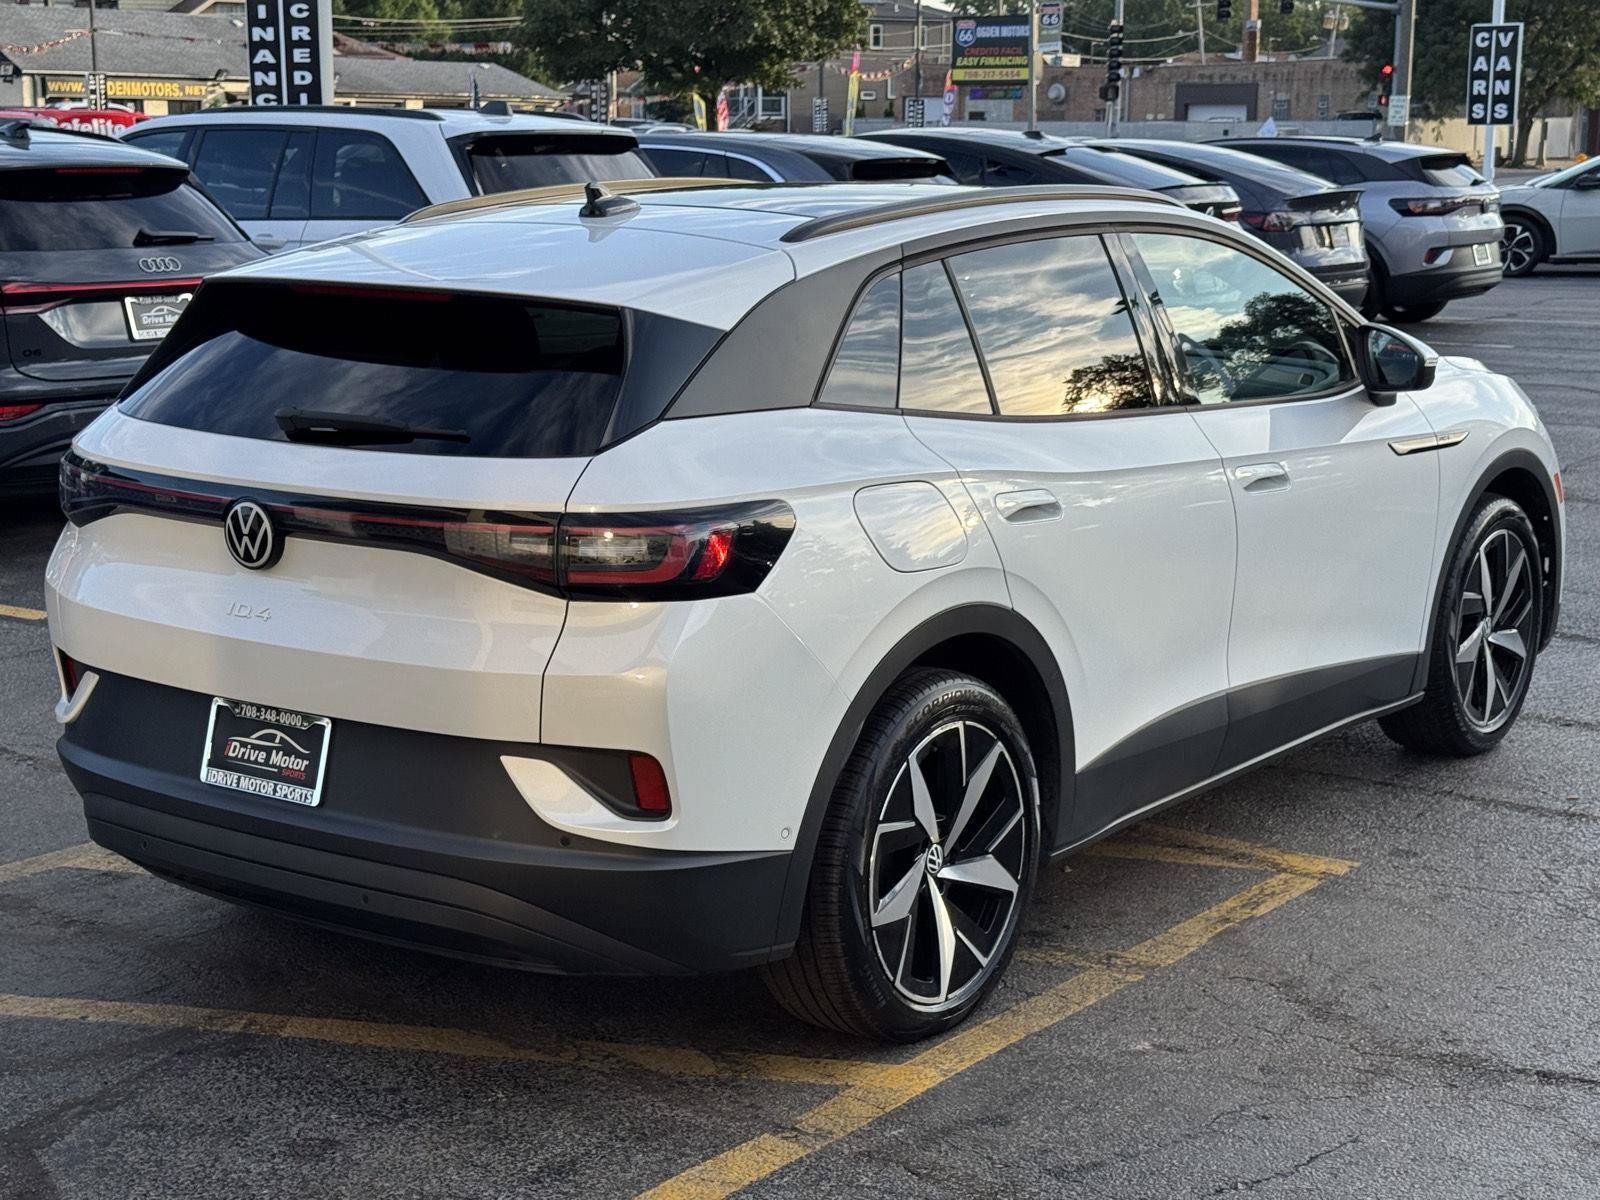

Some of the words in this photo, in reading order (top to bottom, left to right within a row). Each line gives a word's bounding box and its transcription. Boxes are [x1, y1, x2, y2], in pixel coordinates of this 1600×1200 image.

[959, 29, 973, 41] 66
[956, 56, 980, 66] EASY
[980, 55, 1028, 66] FINANCING
[1471, 31, 1490, 119] CARS
[1493, 31, 1515, 119] VANS
[241, 704, 302, 726] 708-348-0000
[224, 741, 267, 763] iDrive
[269, 749, 310, 771] Motor
[281, 768, 306, 780] SPORTS
[239, 777, 275, 796] MOTOR
[275, 784, 313, 804] SPORTS
